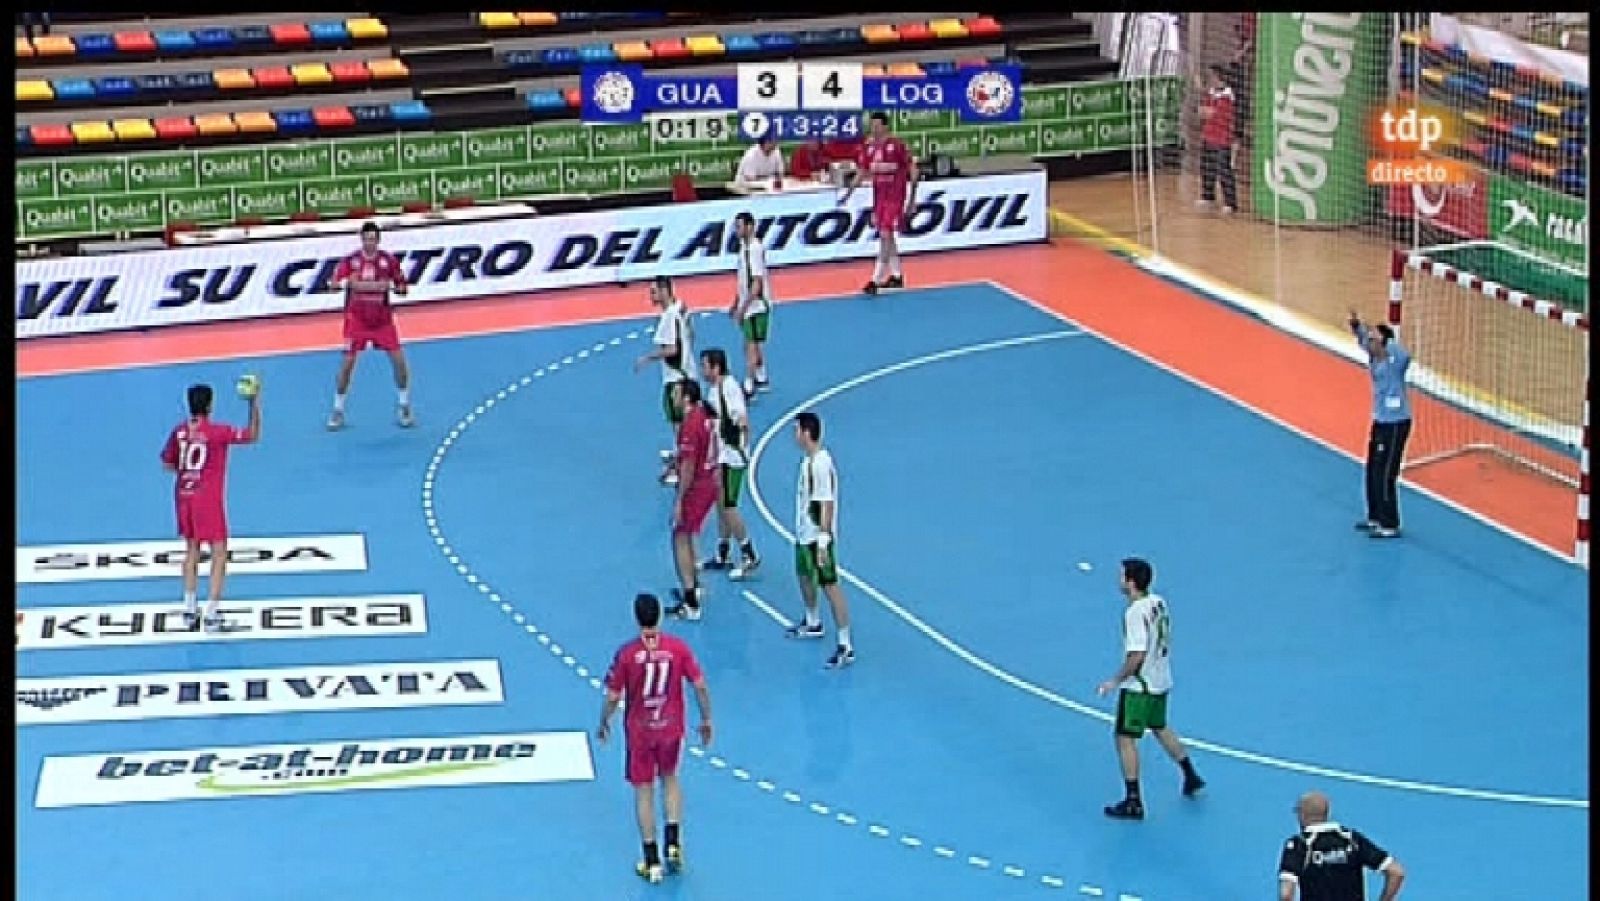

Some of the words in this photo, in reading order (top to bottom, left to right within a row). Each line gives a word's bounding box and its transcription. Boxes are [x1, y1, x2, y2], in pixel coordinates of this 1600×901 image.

[17, 274, 121, 320] VIL
[157, 263, 257, 308] SU
[267, 240, 534, 298] CETRO
[545, 226, 664, 273] DEL
[178, 440, 207, 470] 10
[113, 671, 489, 707] PRIVATA
[643, 661, 670, 696] 11
[97, 743, 537, 779] bet-at-home
